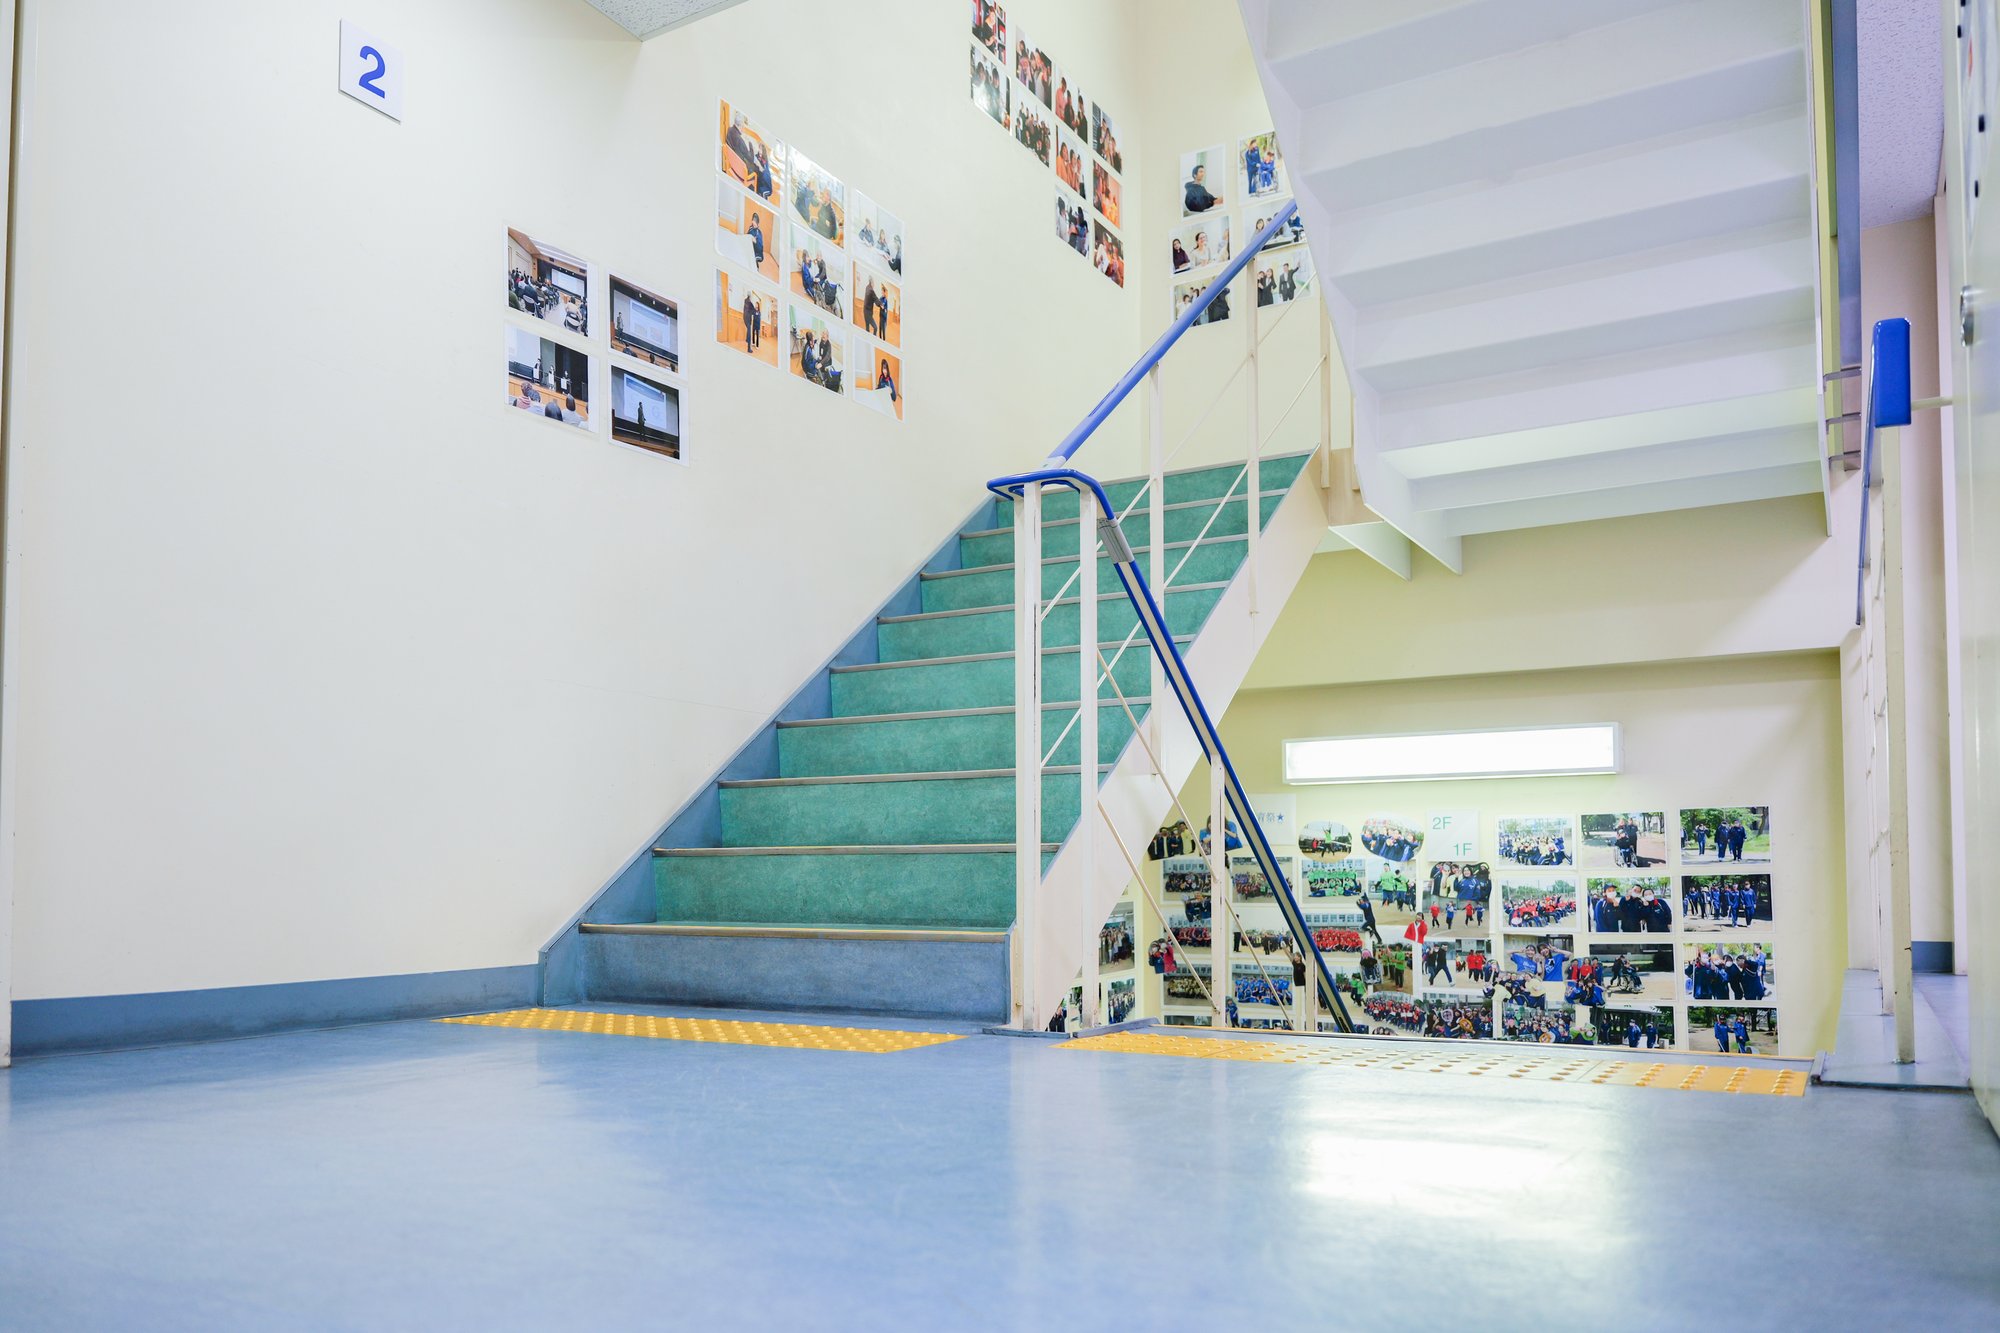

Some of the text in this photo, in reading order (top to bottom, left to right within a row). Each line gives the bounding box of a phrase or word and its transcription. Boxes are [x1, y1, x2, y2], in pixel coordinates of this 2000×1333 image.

[359, 46, 385, 99] 2
[1432, 816, 1452, 830] 2F
[1453, 842, 1472, 856] 1F
